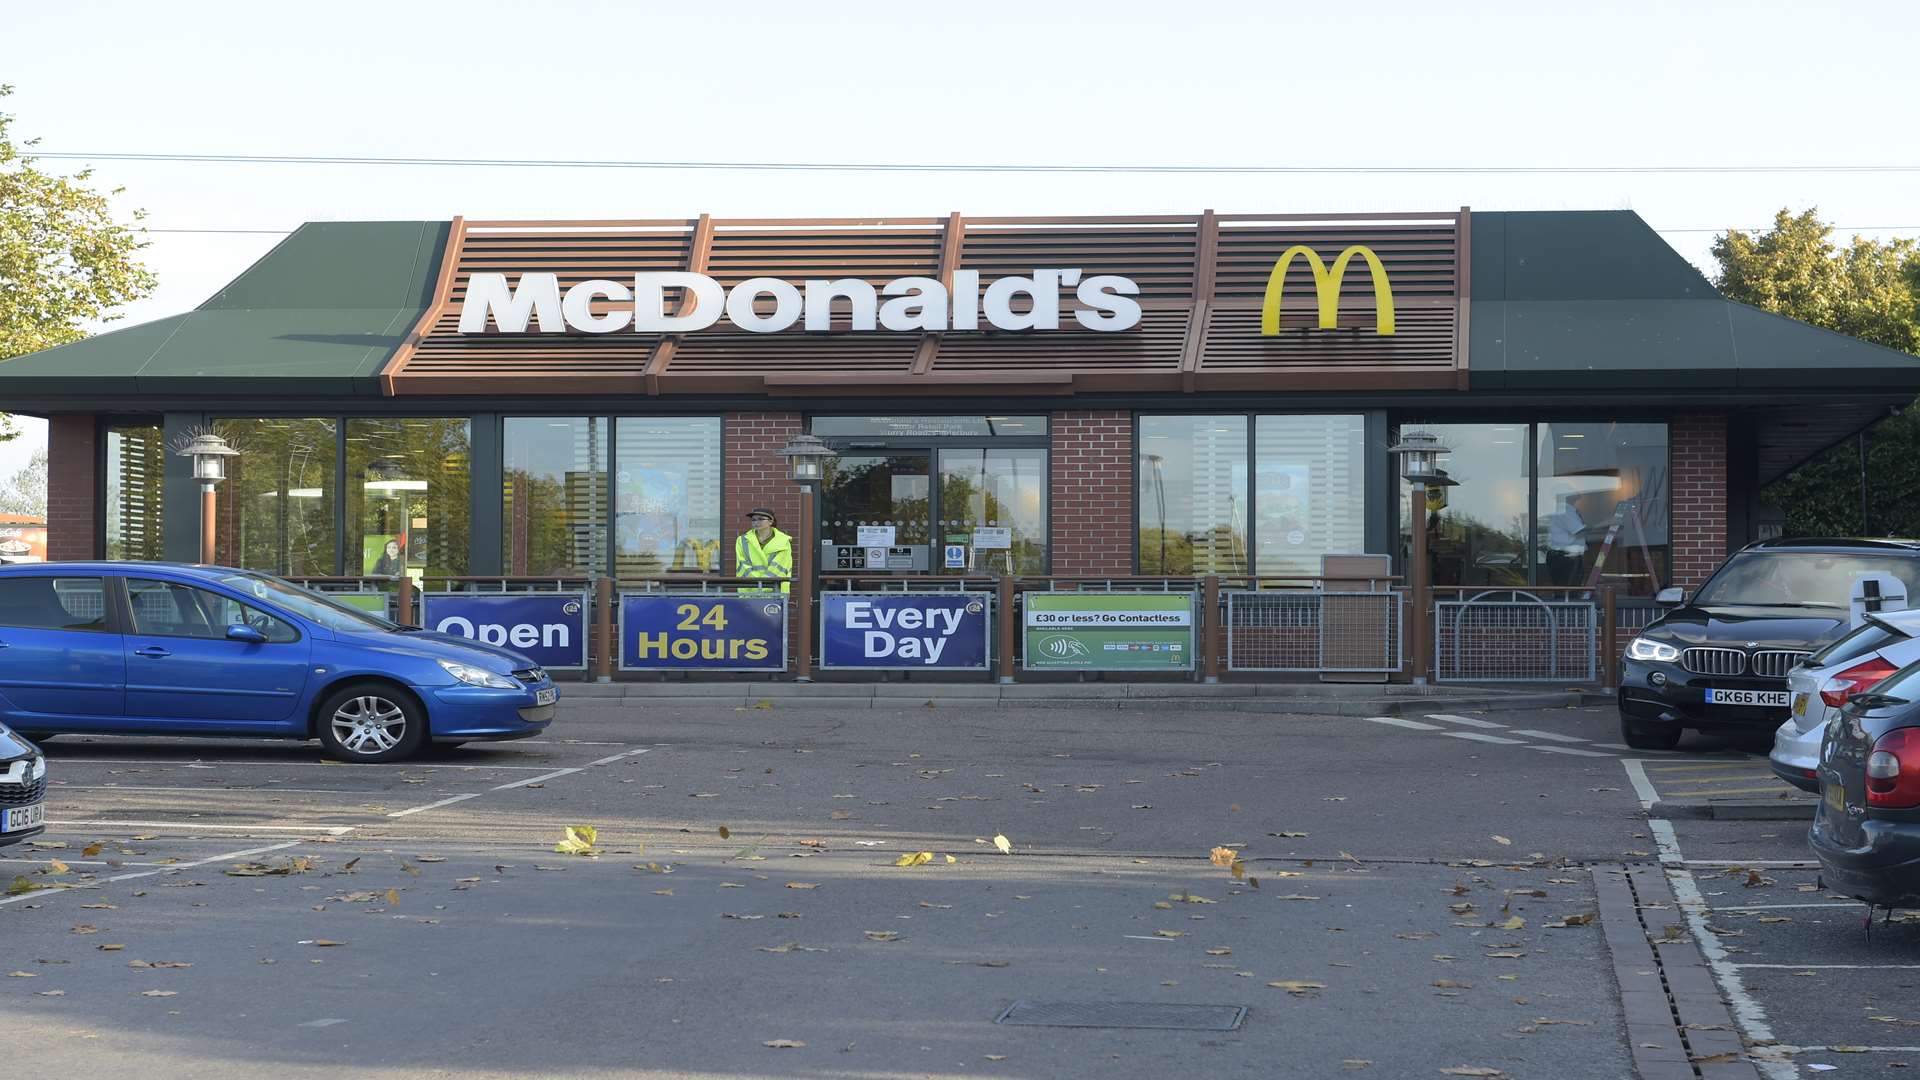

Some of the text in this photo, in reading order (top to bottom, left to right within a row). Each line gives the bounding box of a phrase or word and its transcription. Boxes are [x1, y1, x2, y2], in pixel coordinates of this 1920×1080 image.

[457, 268, 1143, 333] McDonald's
[436, 616, 570, 649] Open
[676, 604, 728, 631] 24
[845, 601, 965, 636] Every
[1036, 614, 1056, 622] £30
[1072, 614, 1100, 622] less?
[1102, 614, 1117, 622] Go
[1118, 614, 1181, 622] Contactless
[639, 631, 769, 660] Hours
[864, 630, 947, 664] Day
[1714, 690, 1753, 703] GK66
[1757, 692, 1787, 705] KHE
